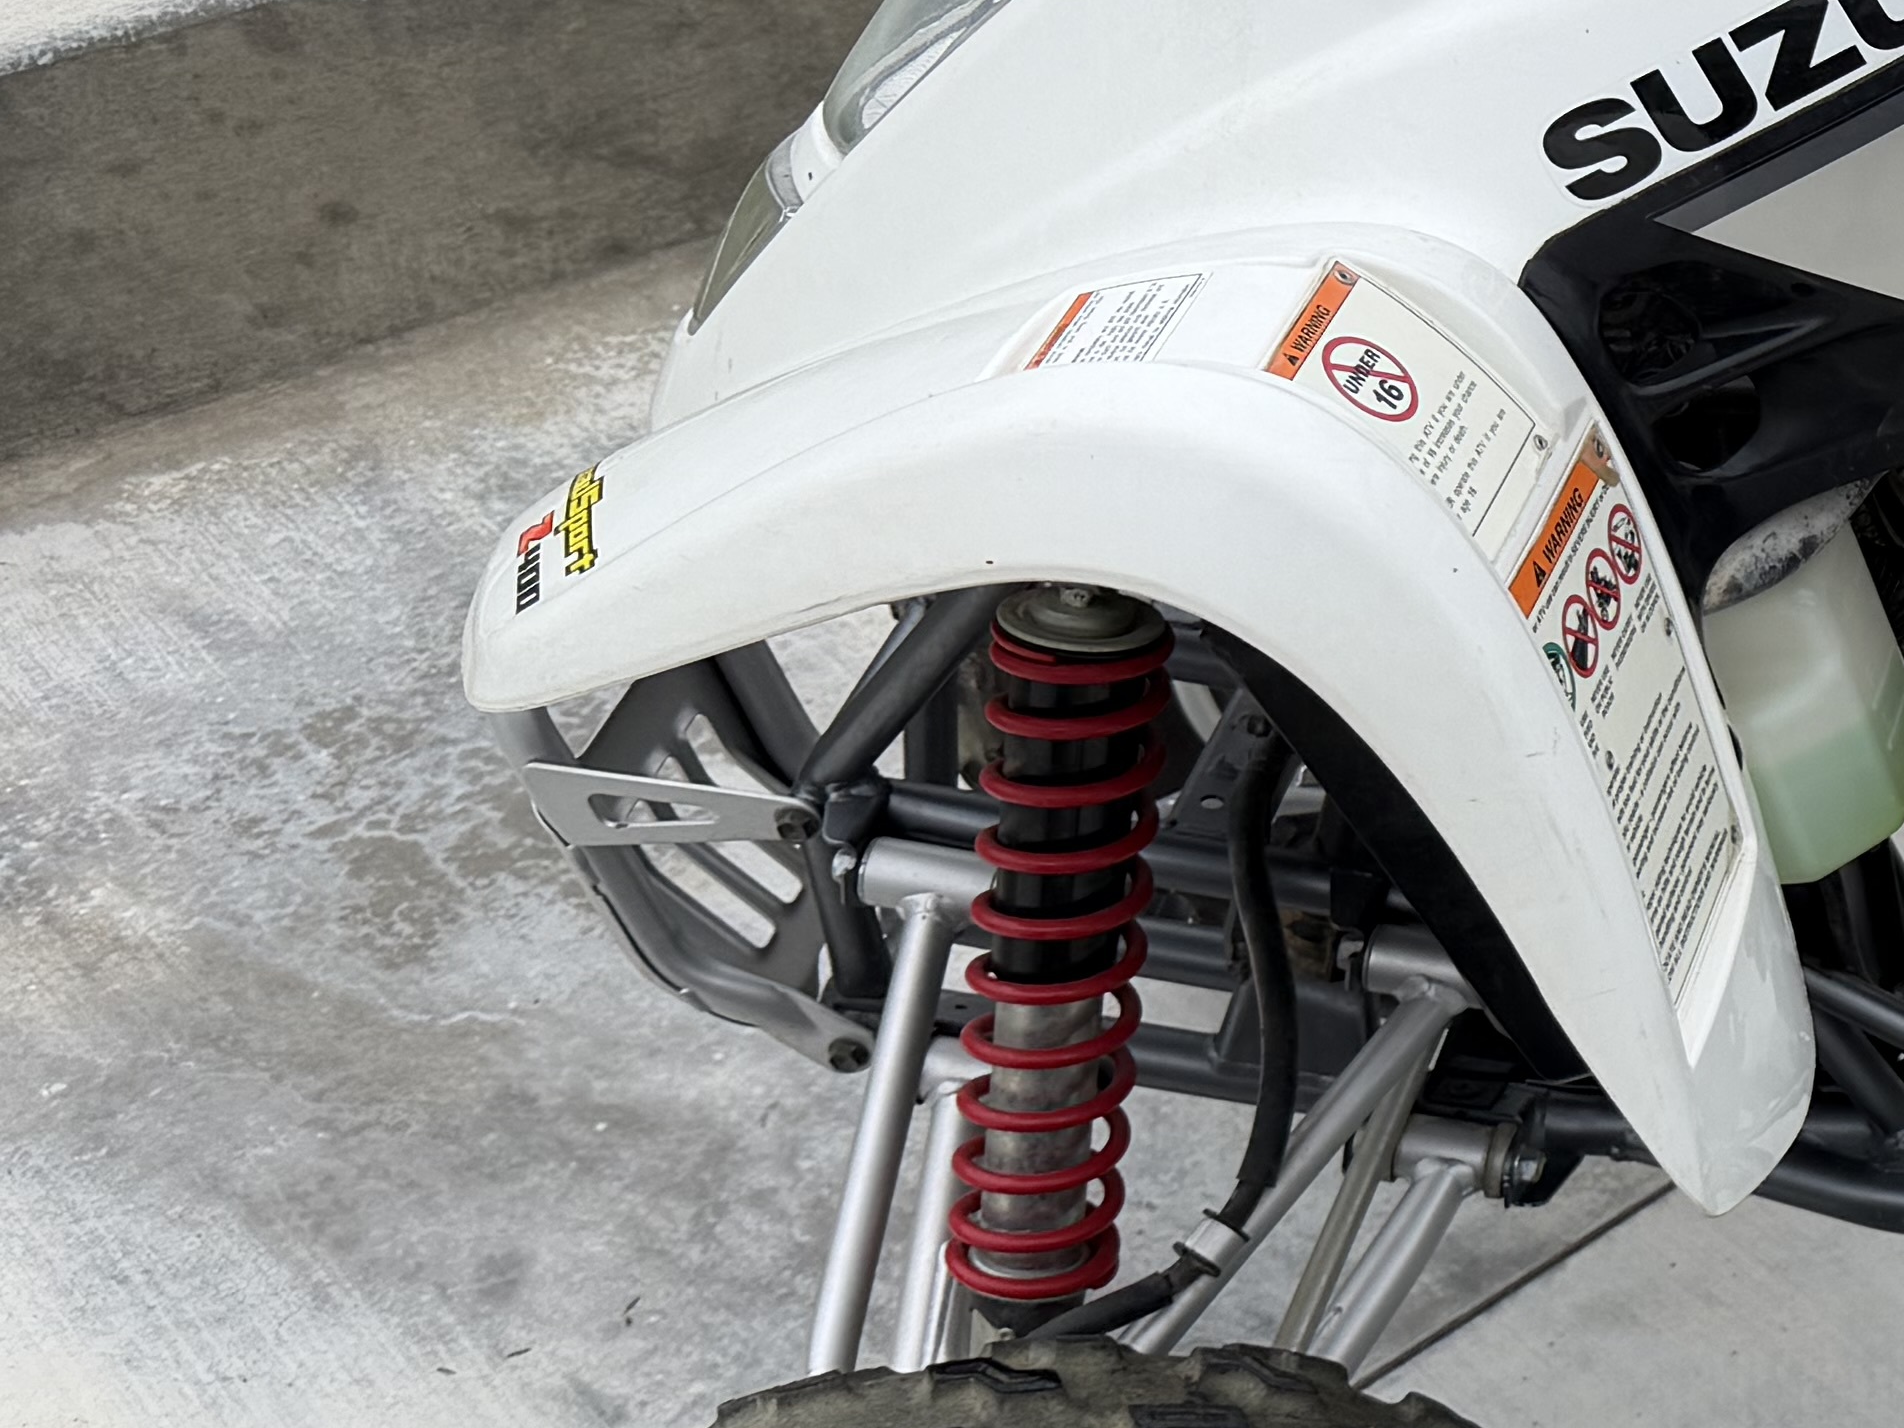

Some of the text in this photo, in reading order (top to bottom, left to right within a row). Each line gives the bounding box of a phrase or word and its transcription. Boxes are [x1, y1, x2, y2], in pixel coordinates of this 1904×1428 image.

[1291, 304, 1331, 352] WARNING
[1343, 348, 1381, 394] UNDER
[1374, 379, 1404, 410] 16
[1543, 487, 1584, 564] WARNING
